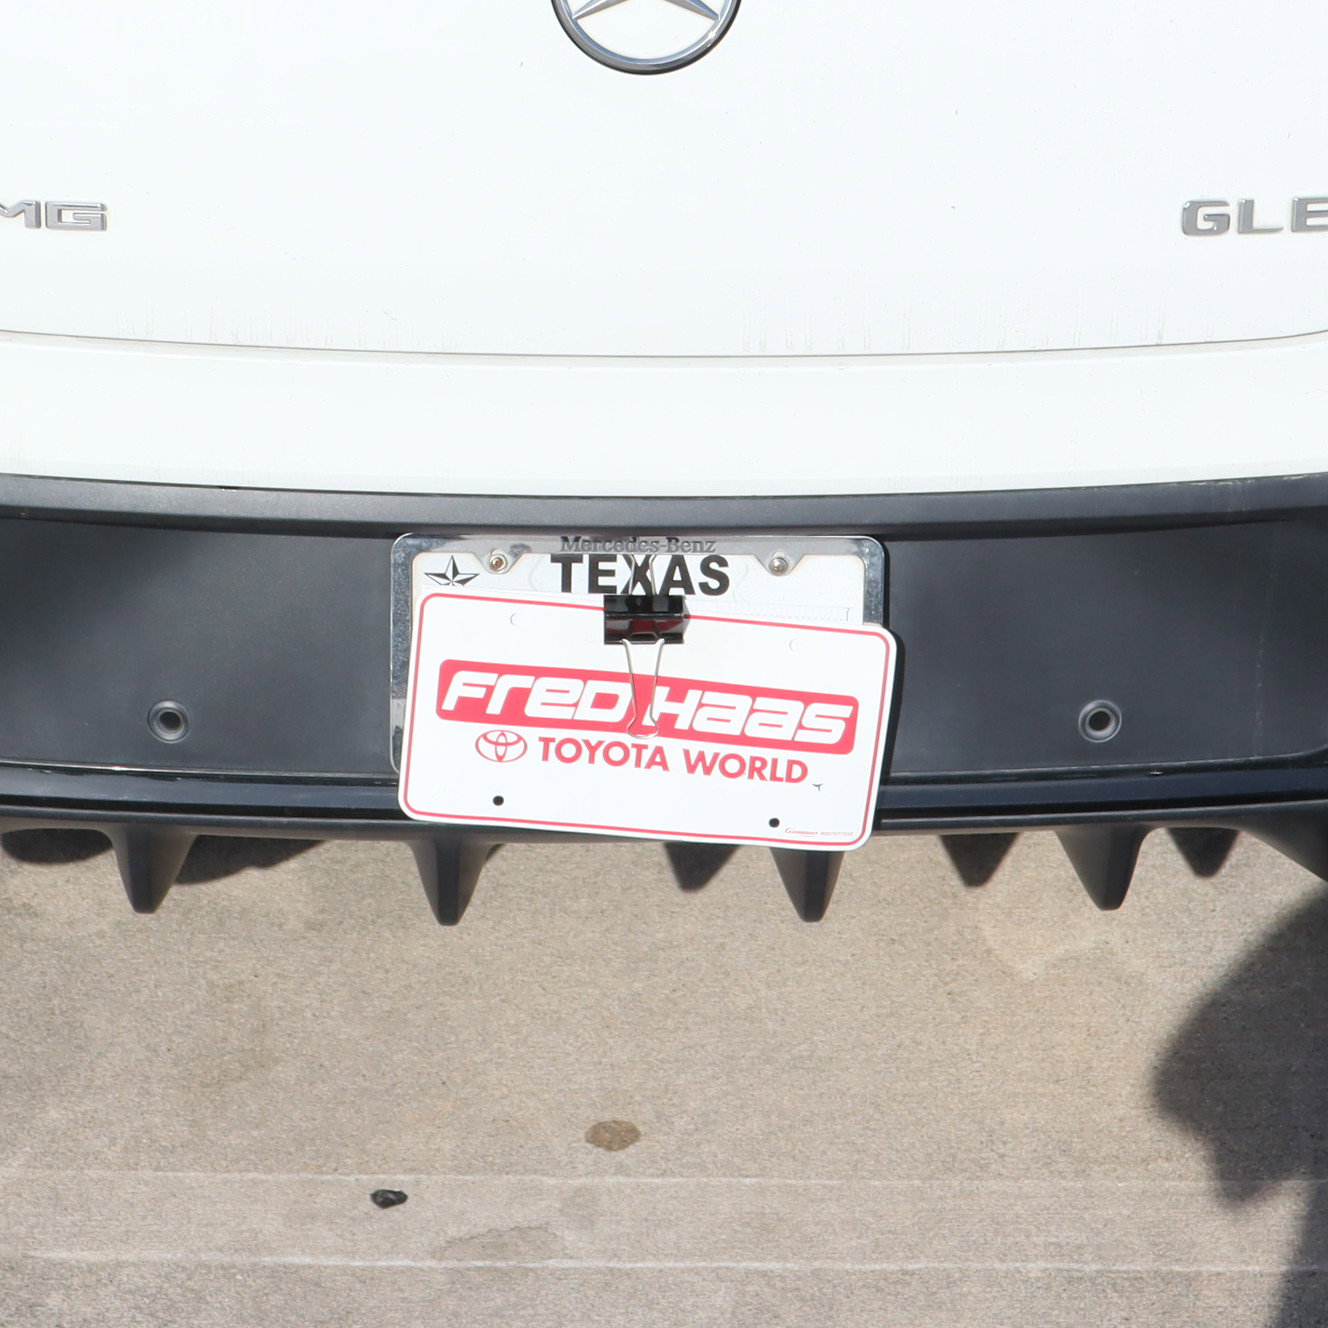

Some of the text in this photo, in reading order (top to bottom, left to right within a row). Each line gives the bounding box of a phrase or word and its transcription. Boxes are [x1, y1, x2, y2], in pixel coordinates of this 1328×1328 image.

[560, 536, 717, 553] Mercedes-Benz
[550, 553, 730, 596] TEXAS
[538, 736, 809, 784] TOYOTA WORLD
